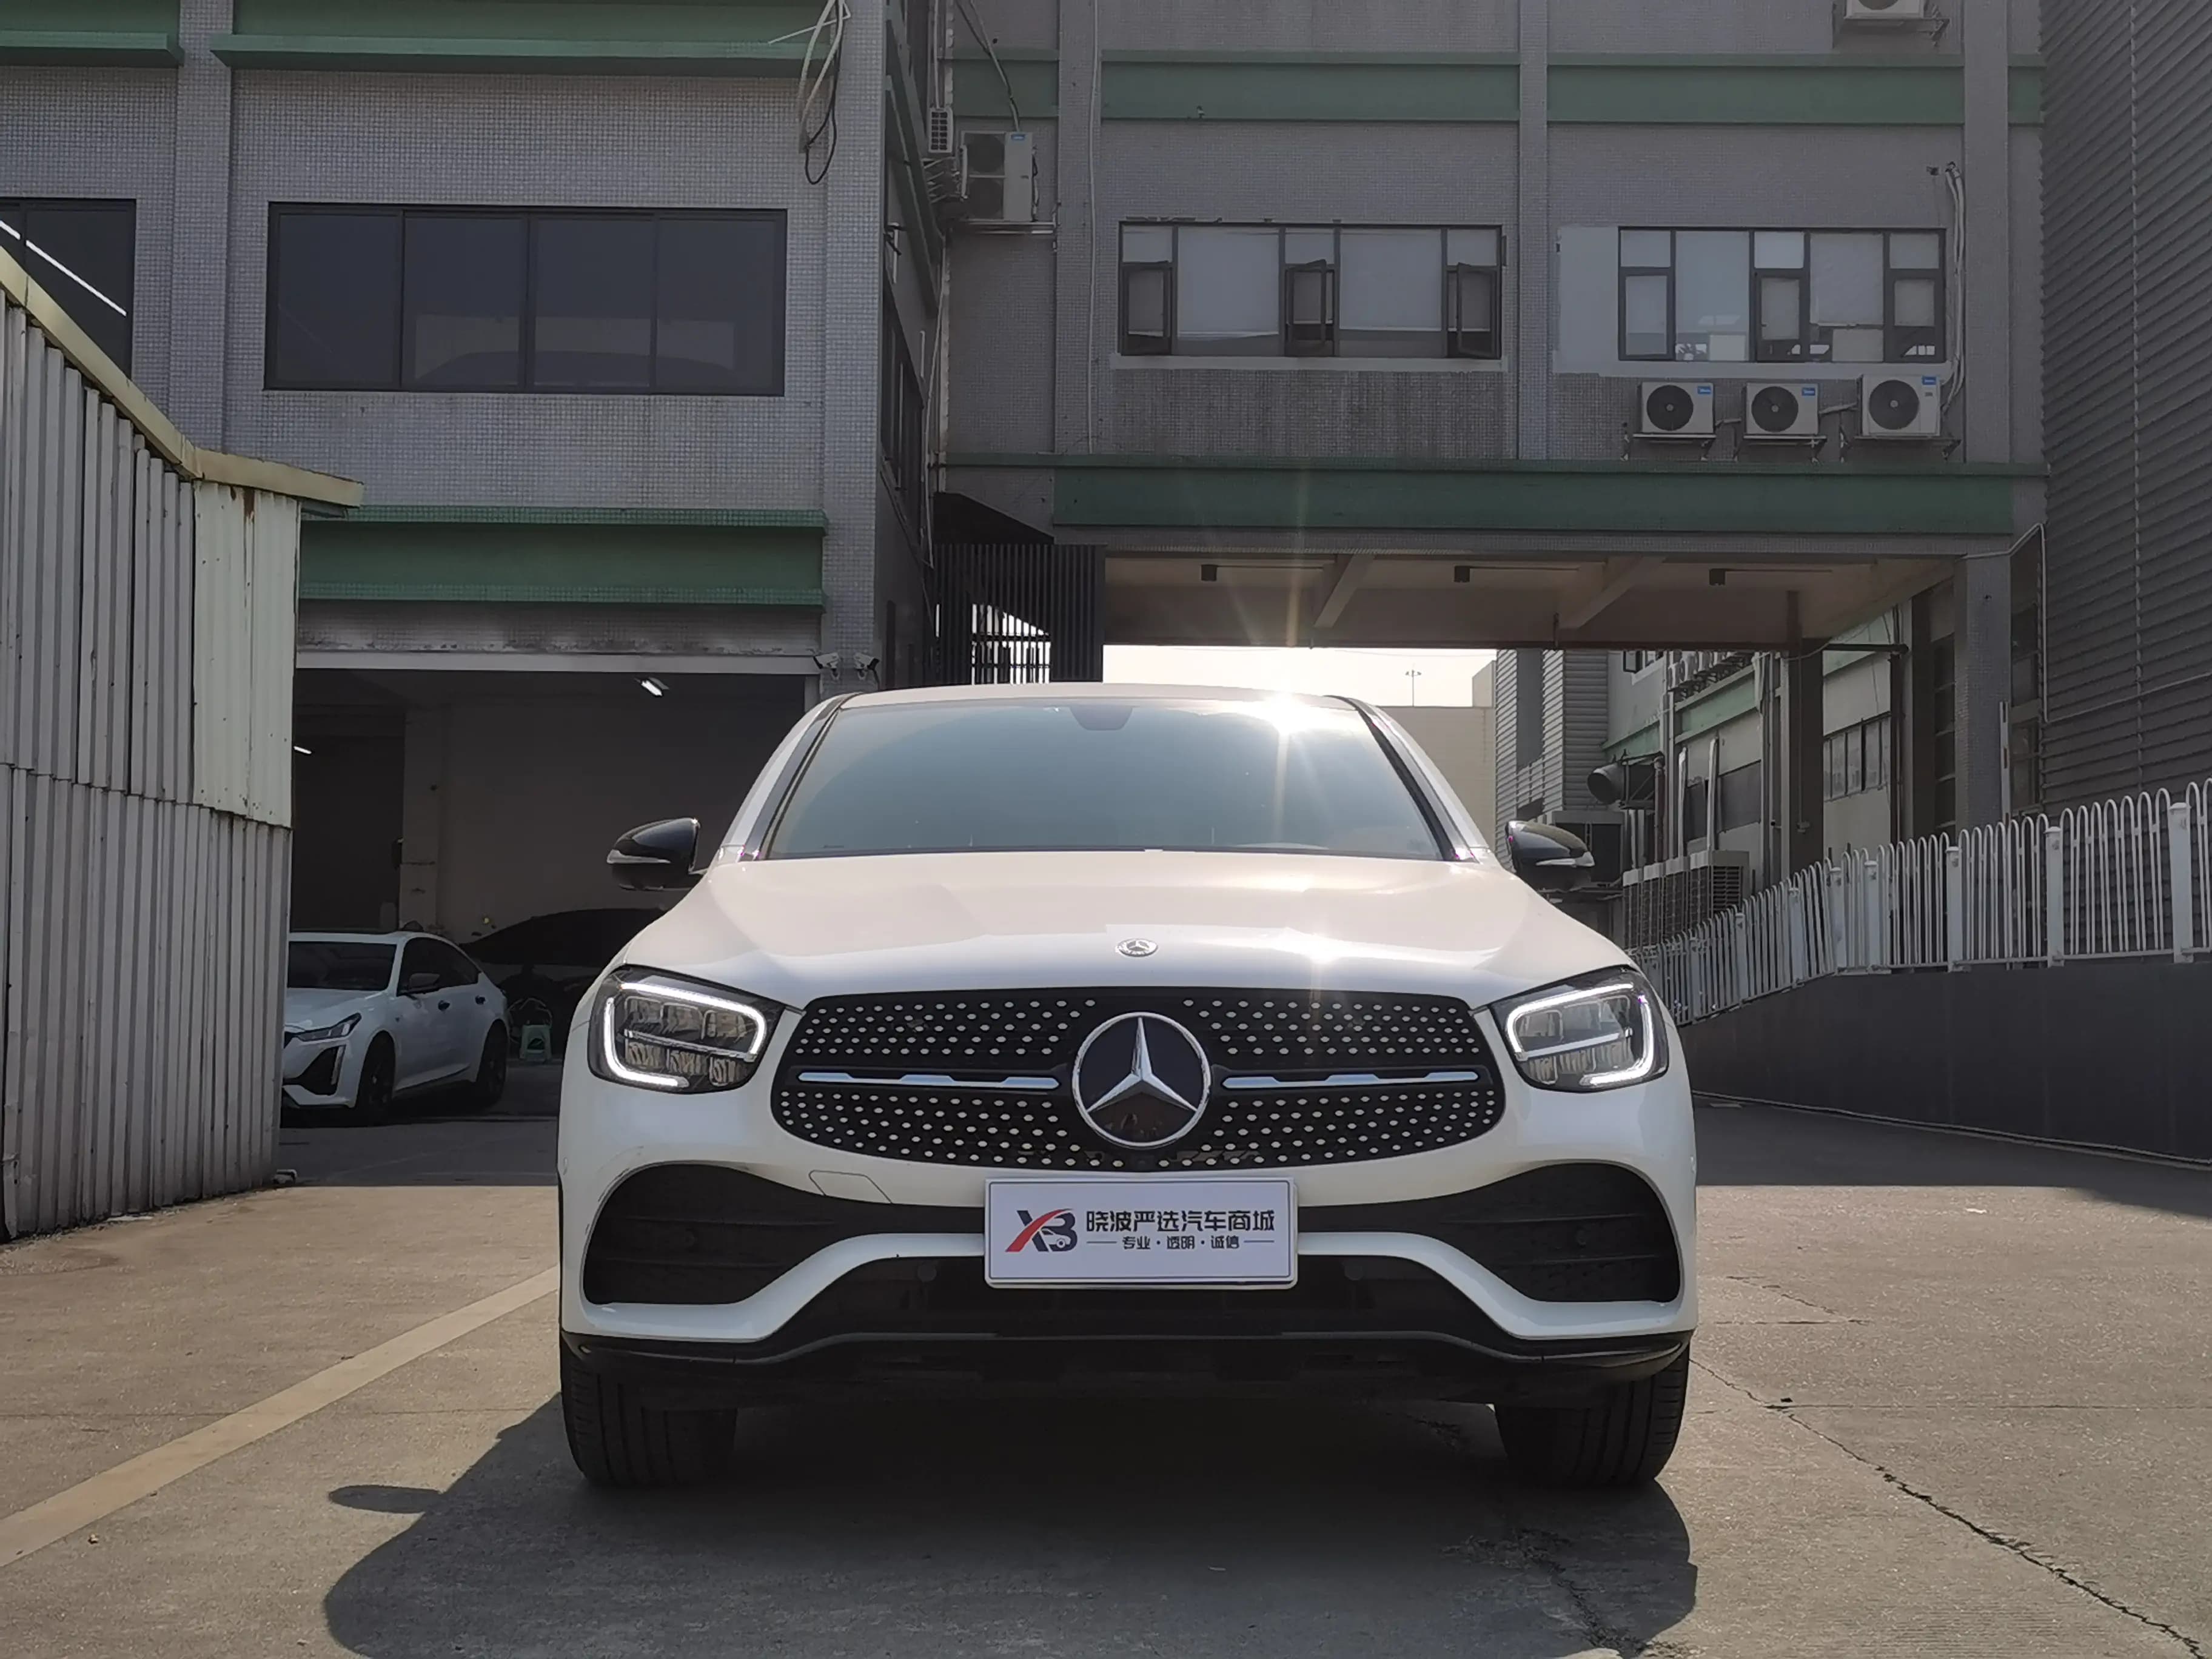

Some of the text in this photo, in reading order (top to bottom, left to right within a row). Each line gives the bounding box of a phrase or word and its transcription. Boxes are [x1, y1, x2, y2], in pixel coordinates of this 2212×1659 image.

[1005, 1208, 1078, 1252] XB
[1086, 1210, 1275, 1232] 晓波严选汽车商城
